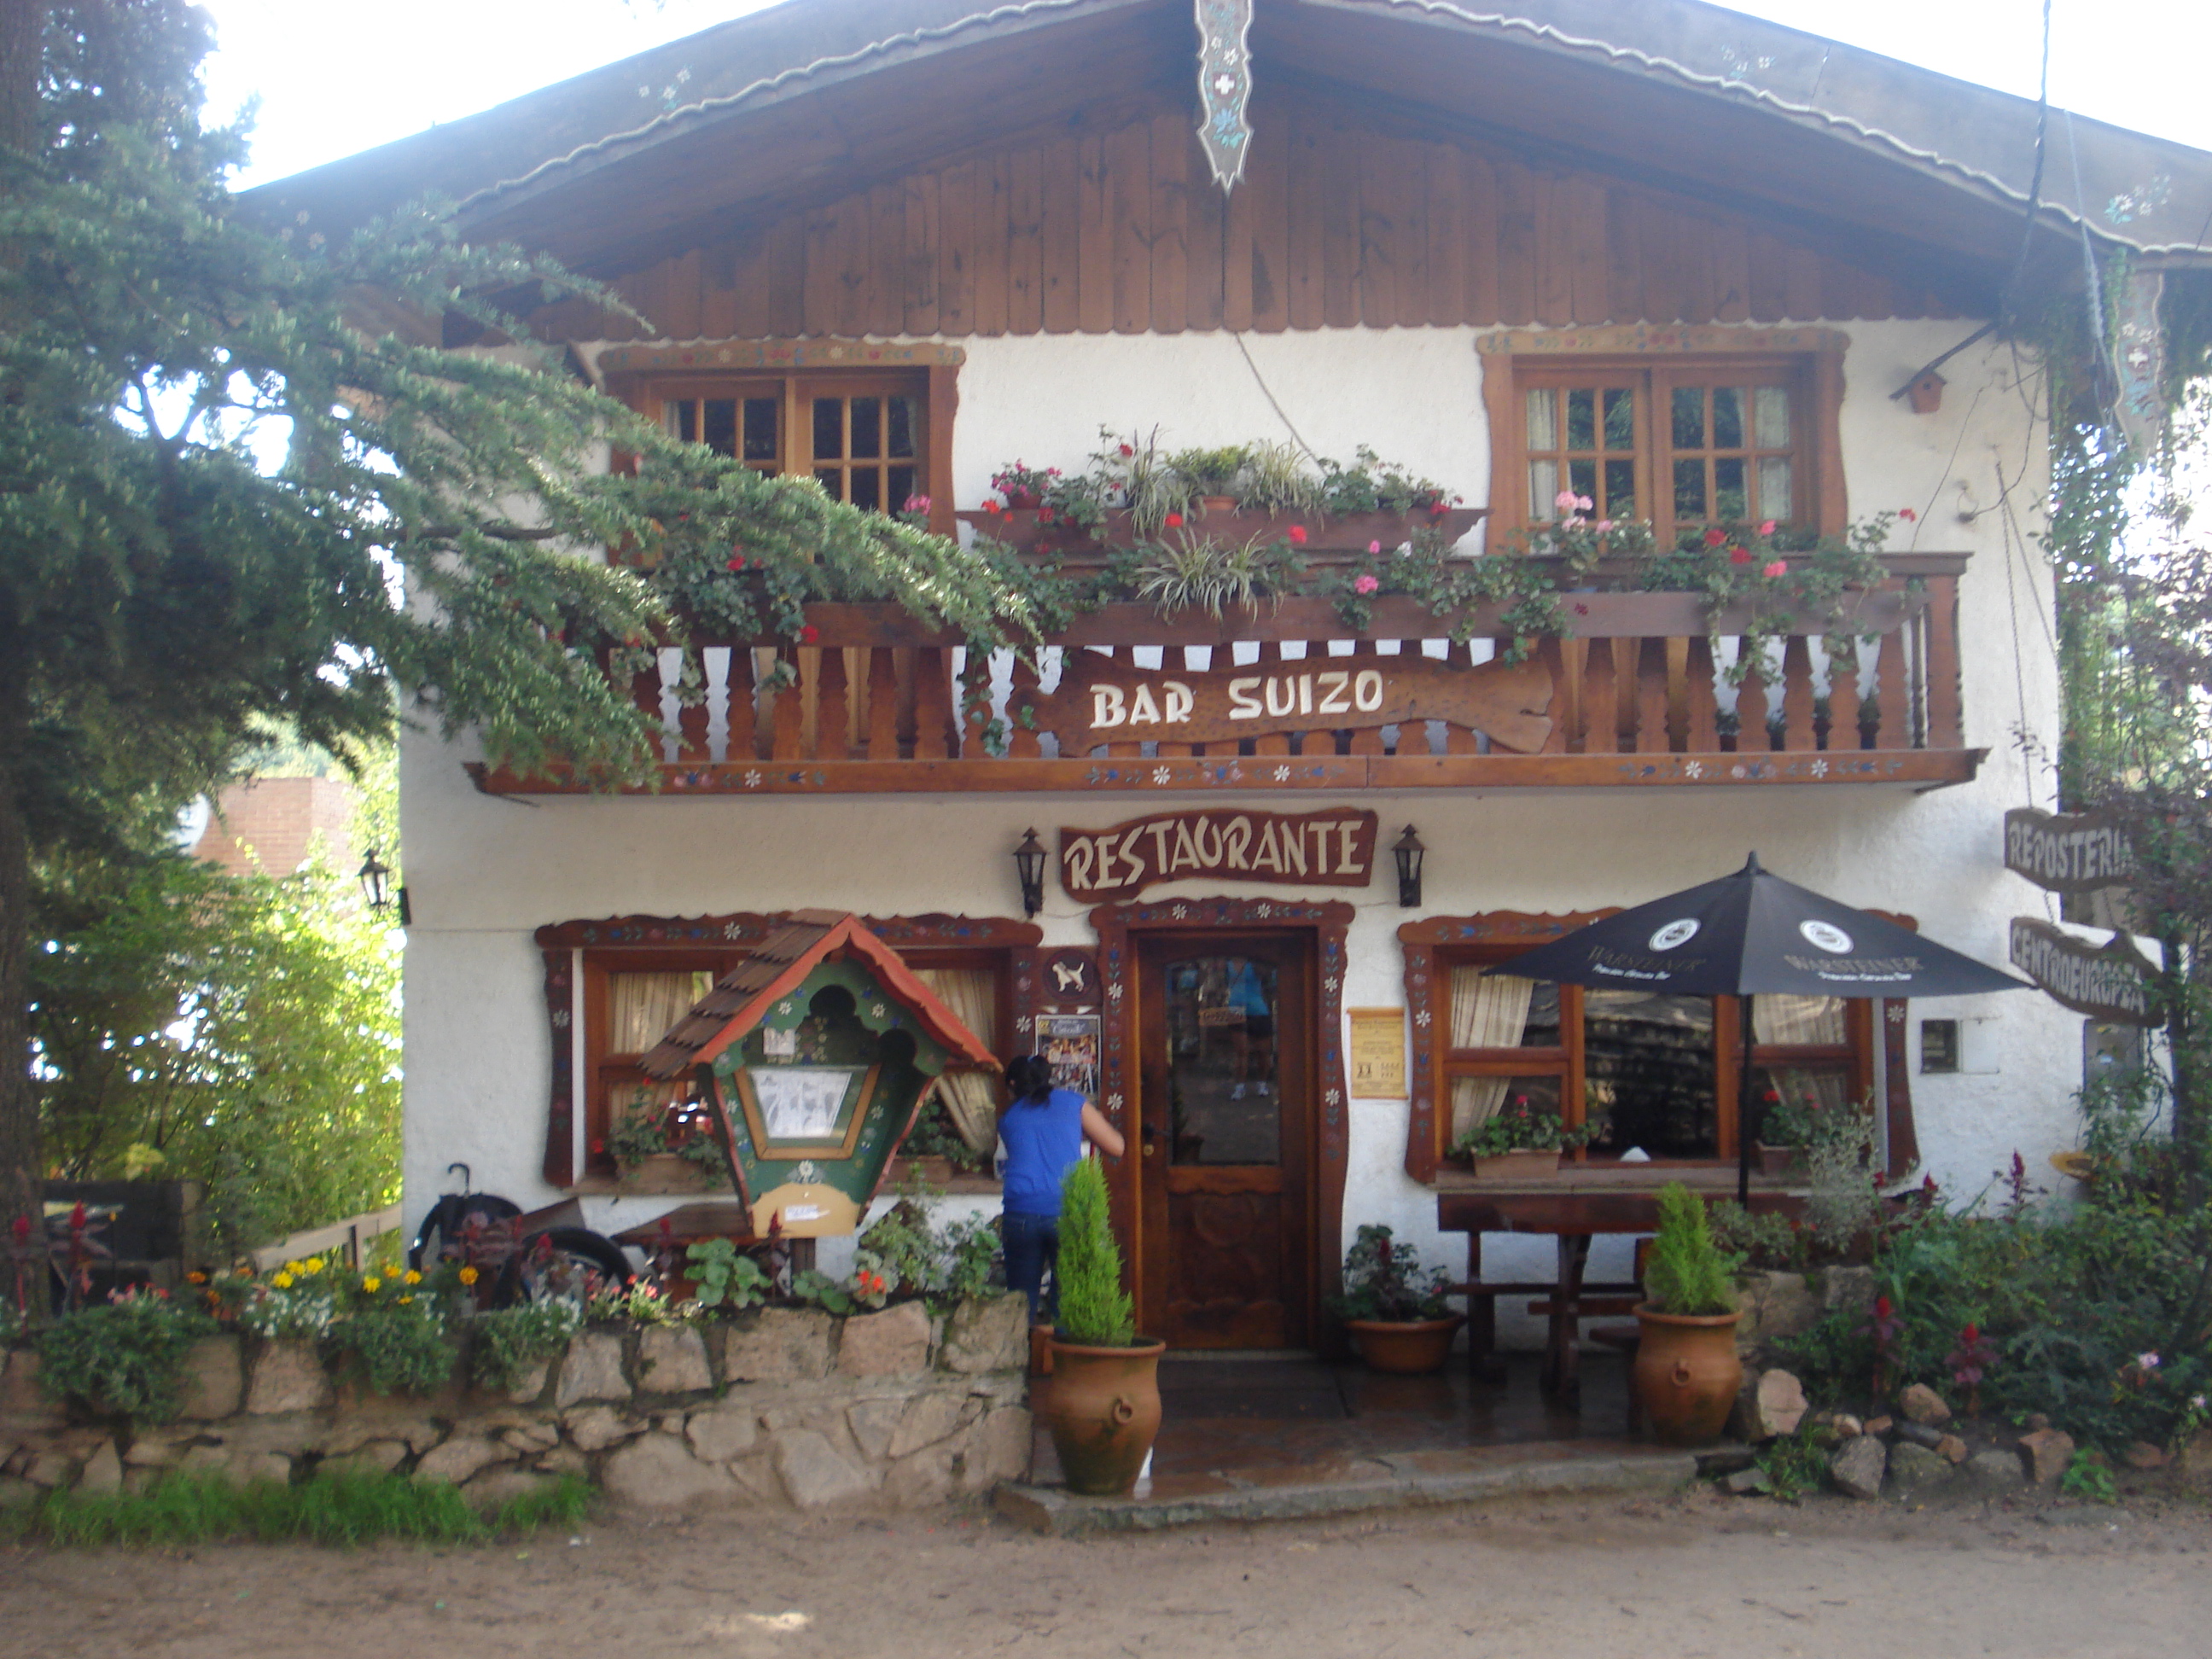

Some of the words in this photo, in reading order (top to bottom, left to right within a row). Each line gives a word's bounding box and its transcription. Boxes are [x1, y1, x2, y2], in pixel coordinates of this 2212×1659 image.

[1089, 681, 1194, 729] BAR
[1228, 670, 1383, 720] SUIZO
[1063, 814, 1365, 890] RESTAURANTE
